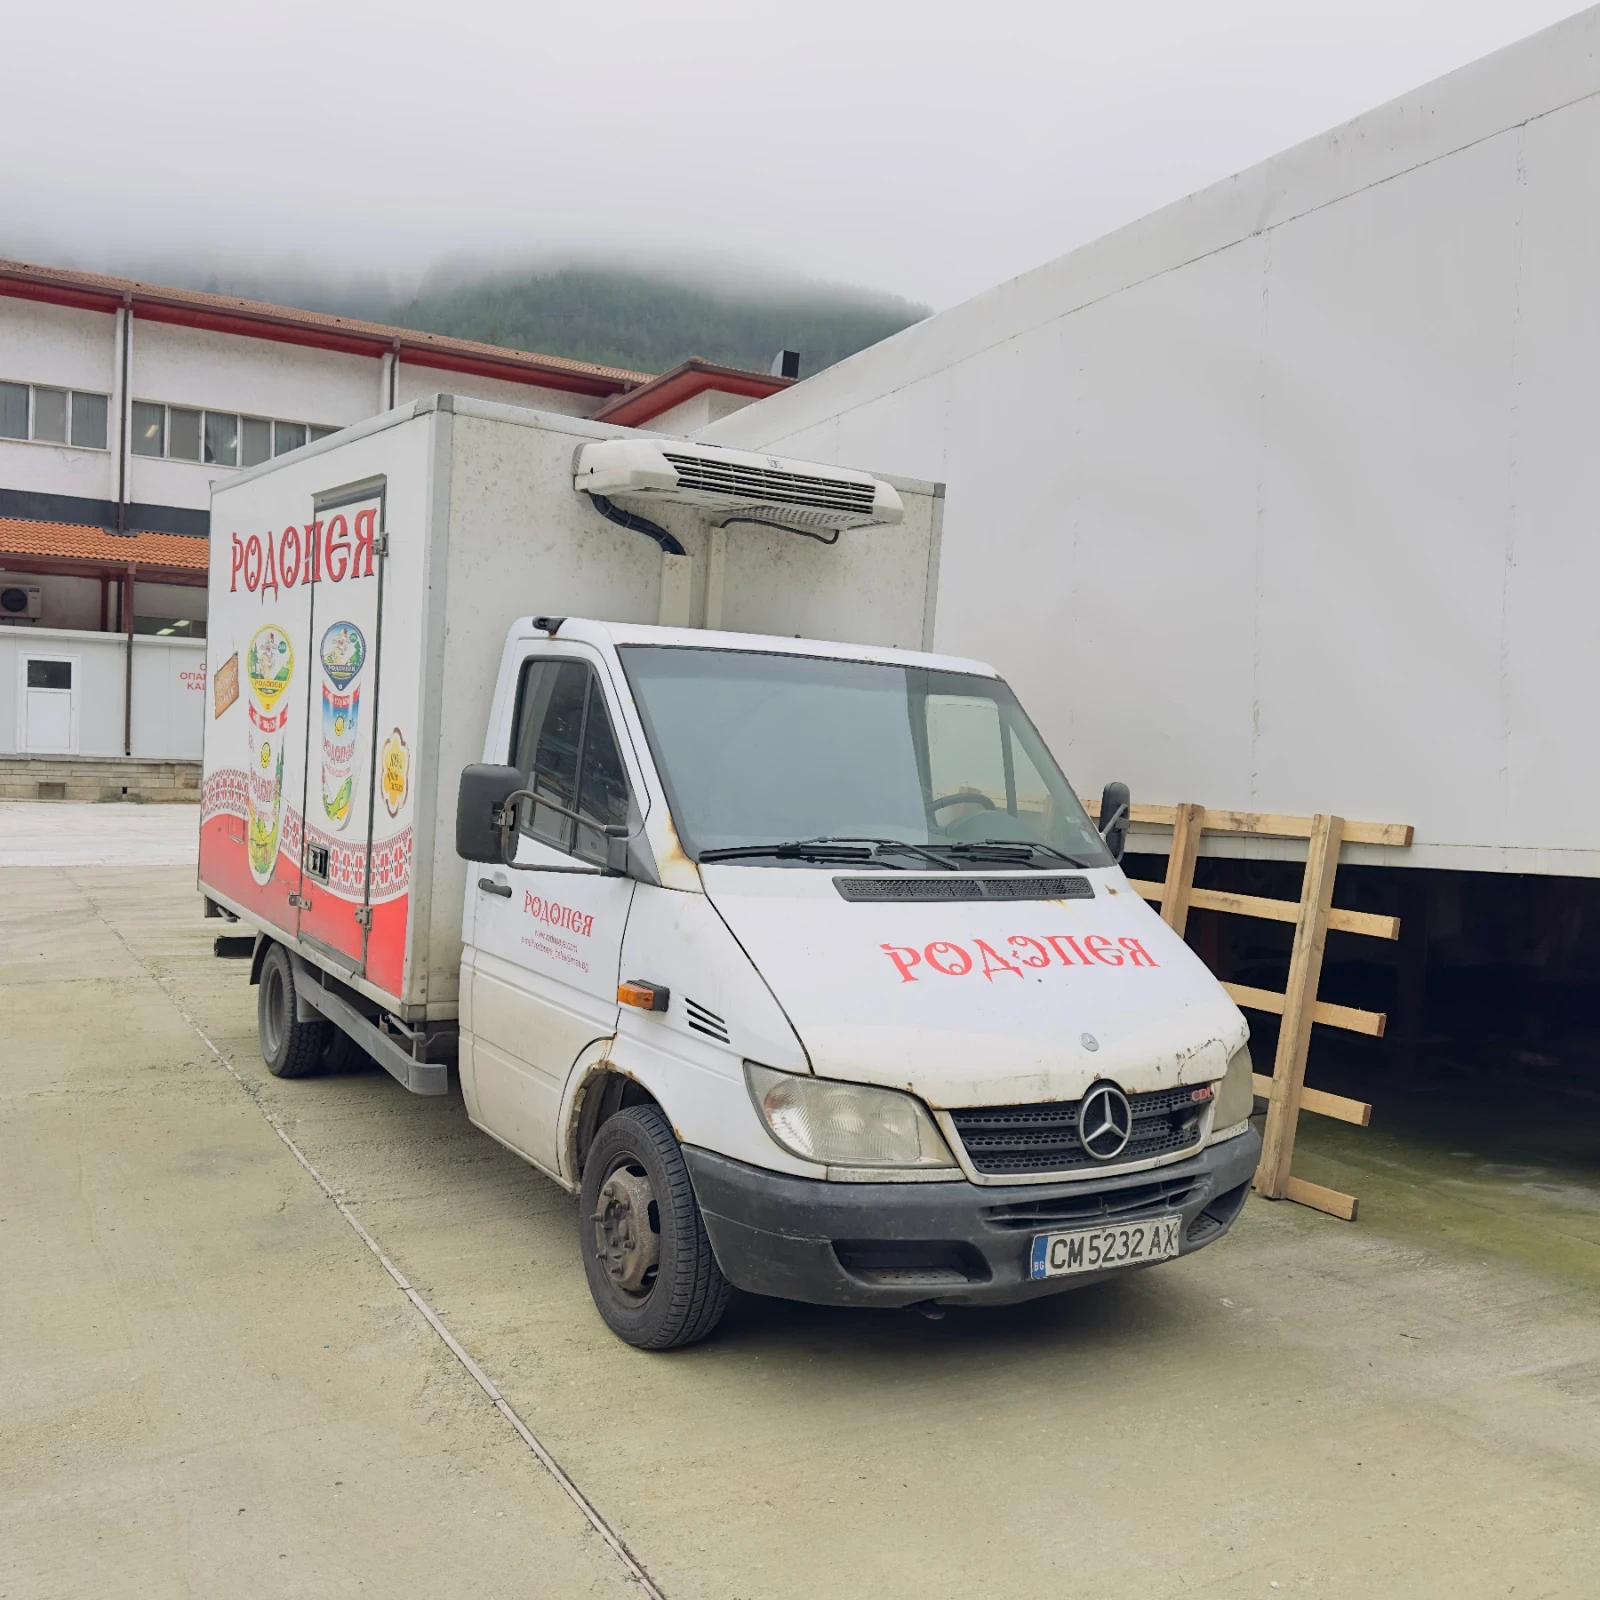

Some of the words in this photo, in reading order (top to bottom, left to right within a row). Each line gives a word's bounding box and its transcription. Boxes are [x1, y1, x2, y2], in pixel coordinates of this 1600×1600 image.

[230, 508, 377, 605] РОДОПЕЯ
[523, 890, 594, 937] РОДОПЕЯ
[1191, 1087, 1211, 1101] CDI
[1034, 1261, 1045, 1271] BG
[1050, 1236, 1085, 1269] CM
[1088, 1229, 1145, 1264] 5232
[1148, 1222, 1178, 1255] AX
